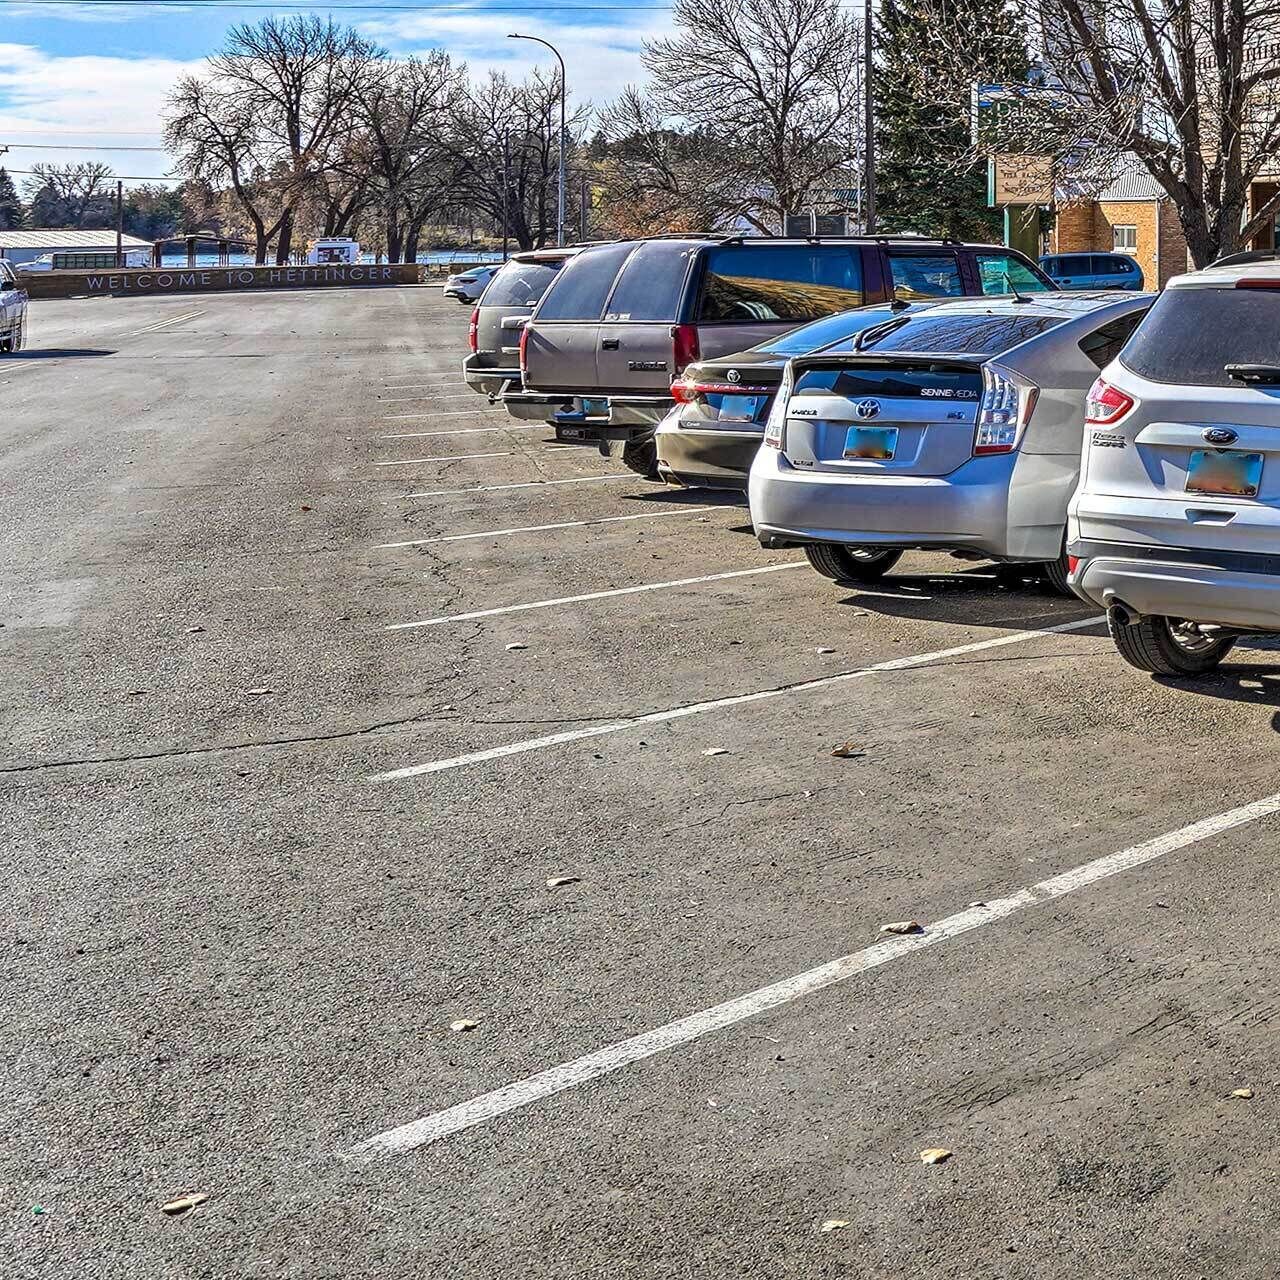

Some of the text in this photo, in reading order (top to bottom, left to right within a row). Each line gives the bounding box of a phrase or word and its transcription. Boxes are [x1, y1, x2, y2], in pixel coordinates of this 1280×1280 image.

[86, 267, 393, 290] WELCOME TO HETTINGER
